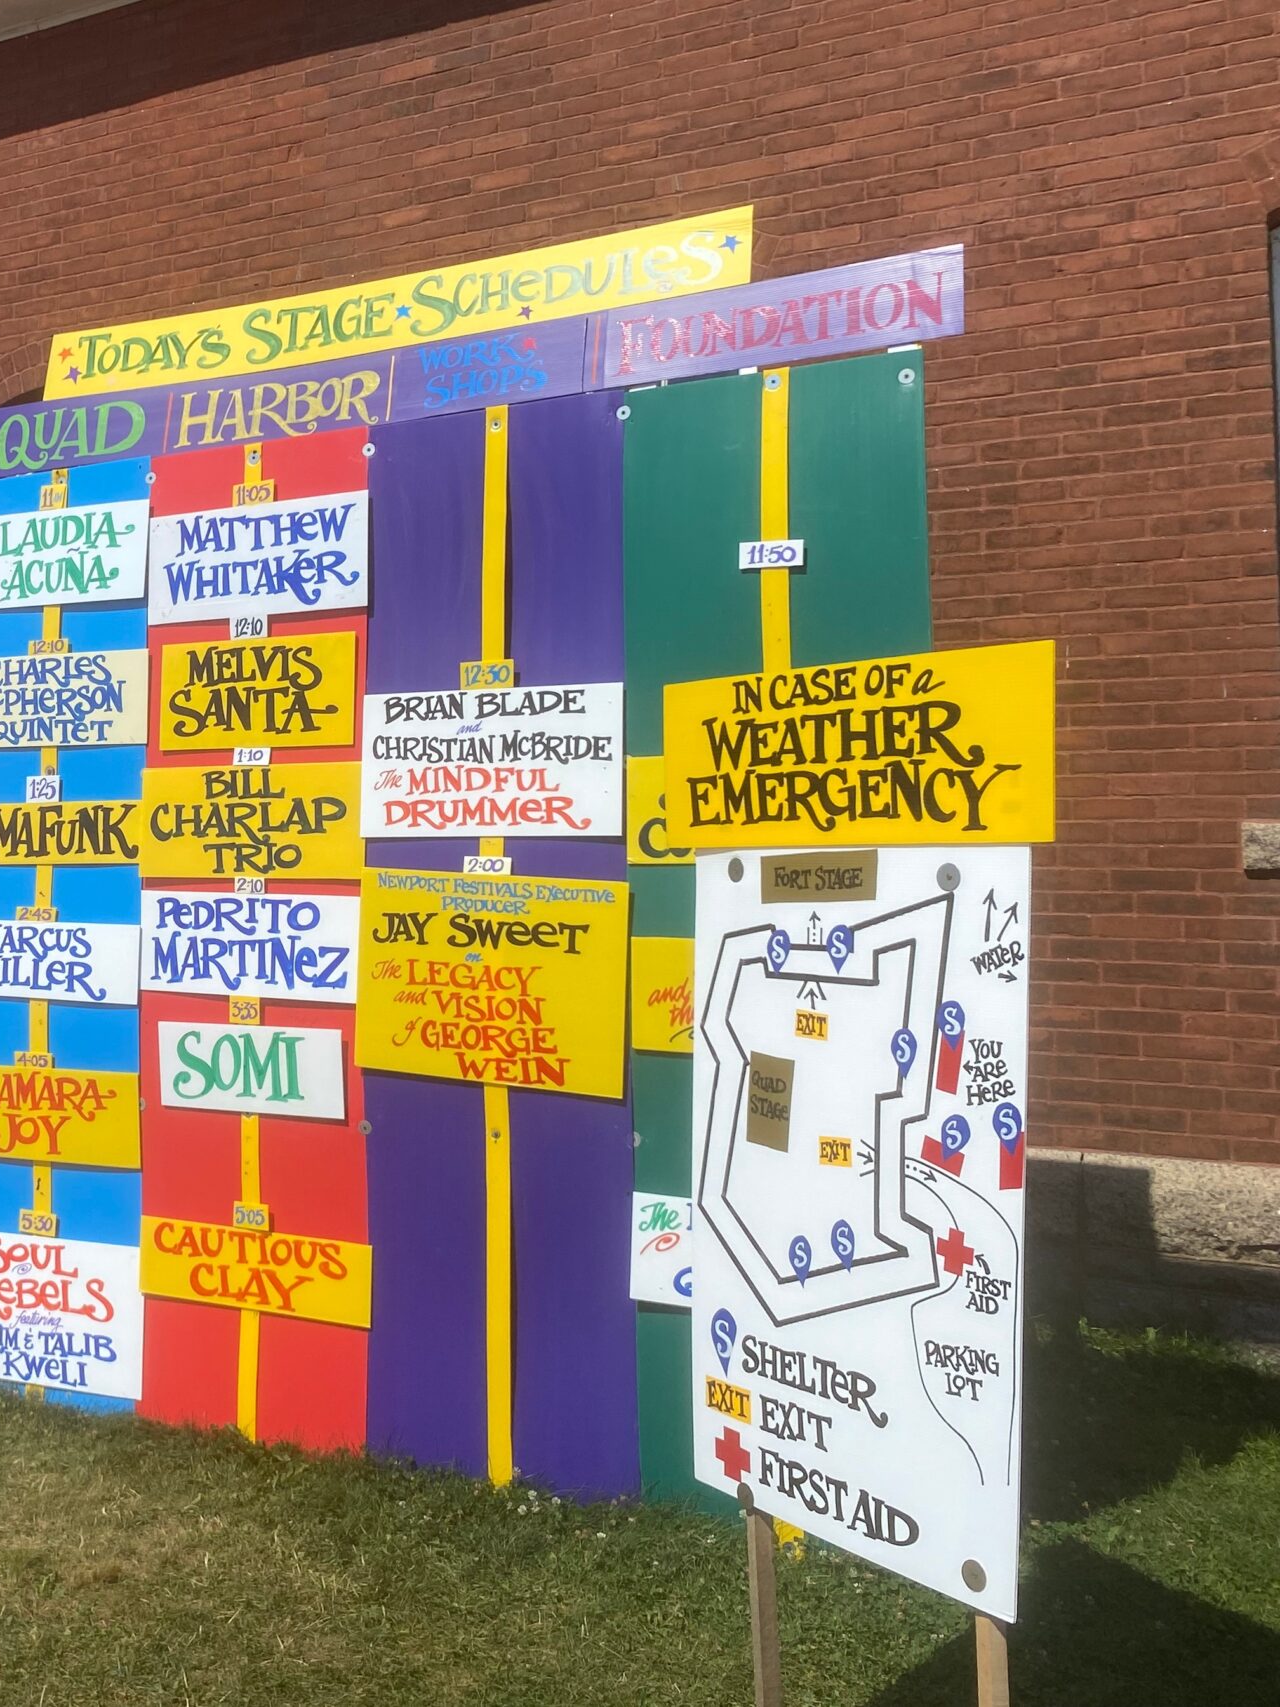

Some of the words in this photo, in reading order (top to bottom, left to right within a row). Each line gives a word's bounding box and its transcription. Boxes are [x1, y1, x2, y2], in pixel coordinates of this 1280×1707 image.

[243, 293, 396, 366] STAGE
[614, 270, 945, 378] FOUNDATION
[418, 332, 523, 370] WORK
[422, 359, 550, 410] SHOPS
[174, 370, 380, 449] HARBOR
[235, 484, 271, 507] 11:05
[746, 545, 797, 565] 11:50
[0, 547, 120, 602] ACUÑA
[234, 617, 264, 638] 12:10
[32, 639, 65, 654] 12:10
[184, 645, 323, 691] MELVIS
[463, 664, 510, 687] 12:30
[731, 676, 763, 715] IN
[769, 666, 858, 711] CASE
[864, 662, 912, 697] OF
[170, 686, 339, 737] SANTA
[384, 692, 468, 724] BRIAN
[475, 689, 586, 720] BLADE
[456, 721, 482, 735] and
[701, 700, 985, 772] WEATHER
[237, 749, 264, 763] 1:10
[372, 734, 495, 764] CHRISTIAN
[29, 778, 57, 800] 1:25
[202, 768, 286, 800] BILL
[374, 769, 403, 791] The
[406, 765, 561, 796] MINDFUL
[685, 759, 1023, 832] EMERGENCY
[150, 796, 347, 845] CHARLAP
[203, 842, 302, 874] TRIO
[468, 858, 505, 873] 2:00
[236, 879, 263, 893] 2:10
[377, 872, 450, 892] NEWPORT
[773, 866, 811, 890] FORT
[815, 865, 863, 890] STAGE
[19, 907, 52, 921] 2:45
[372, 912, 438, 945] JAY
[371, 958, 403, 980] The
[406, 959, 543, 997] LEGACY
[232, 1001, 259, 1020] 3:35
[393, 988, 428, 1005] and
[431, 990, 546, 1026] VISION
[420, 1019, 558, 1058] GEORGE
[796, 1013, 827, 1037] EXIT
[17, 1053, 49, 1068] 4:05
[173, 1030, 306, 1103] SOMI
[968, 1039, 1003, 1064] YOU
[454, 1052, 572, 1087] WEIN
[751, 1070, 787, 1094] QUAD
[820, 1140, 851, 1162] EXIT
[21, 1214, 53, 1232] 5:30
[235, 1206, 266, 1226] 5:05
[638, 1202, 682, 1231] The
[153, 1221, 348, 1280] CAUTIOUS
[189, 1263, 314, 1312] CLAY
[965, 1270, 1012, 1300] FIRST
[965, 1292, 999, 1315] AID
[9, 1310, 63, 1333] featuring
[38, 1332, 117, 1362] TALIB
[924, 1340, 999, 1377] PARKING
[945, 1372, 983, 1401] LOT
[706, 1378, 750, 1418] EXIT
[759, 1394, 833, 1452] EXIT
[757, 1446, 849, 1522] FIRST
[847, 1489, 920, 1547] AID
